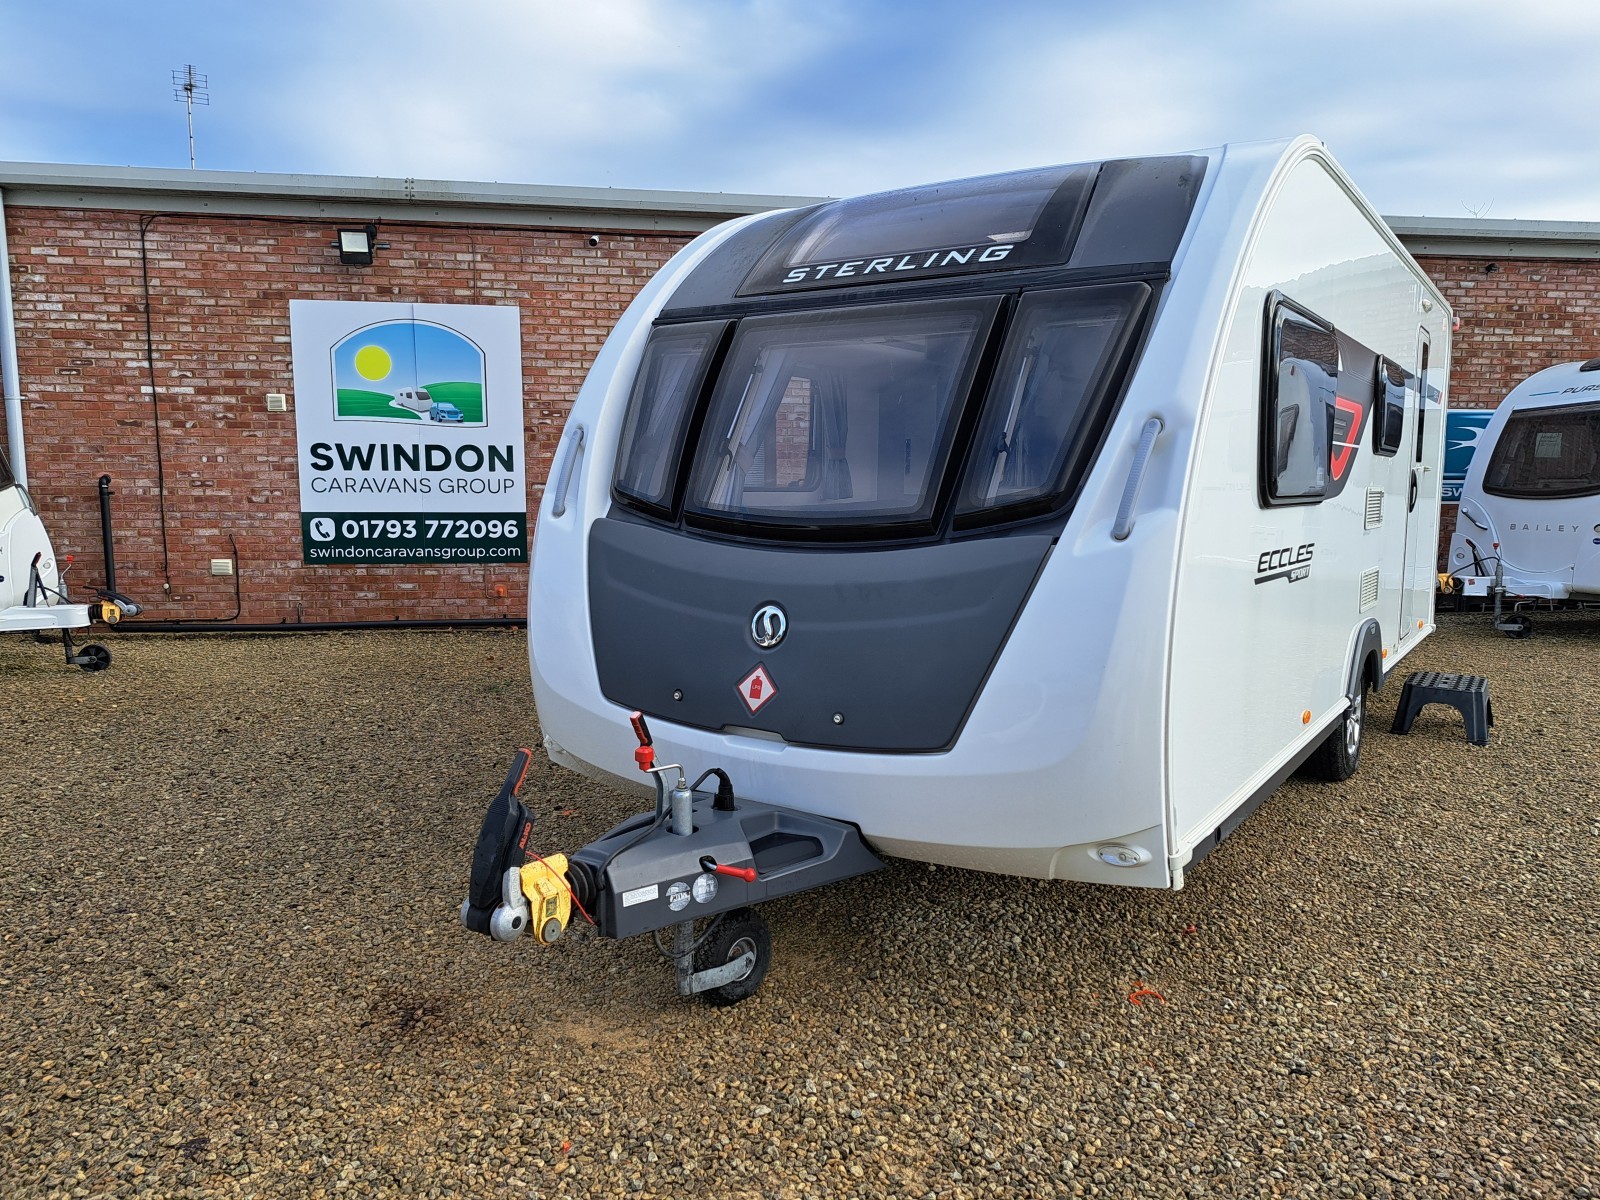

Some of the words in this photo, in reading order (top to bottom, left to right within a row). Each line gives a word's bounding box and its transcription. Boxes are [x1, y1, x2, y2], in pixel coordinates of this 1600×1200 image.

[782, 244, 1014, 283] STERLING
[310, 443, 514, 472] SWINDON
[310, 477, 433, 494] CARAVANS
[438, 478, 515, 494] GROUP
[341, 519, 417, 539] 01793
[424, 519, 519, 539] 772096
[1510, 523, 1579, 532] BAILEY
[309, 545, 522, 559] swindoncaravansgroup.com
[1258, 543, 1315, 573] ECCLES
